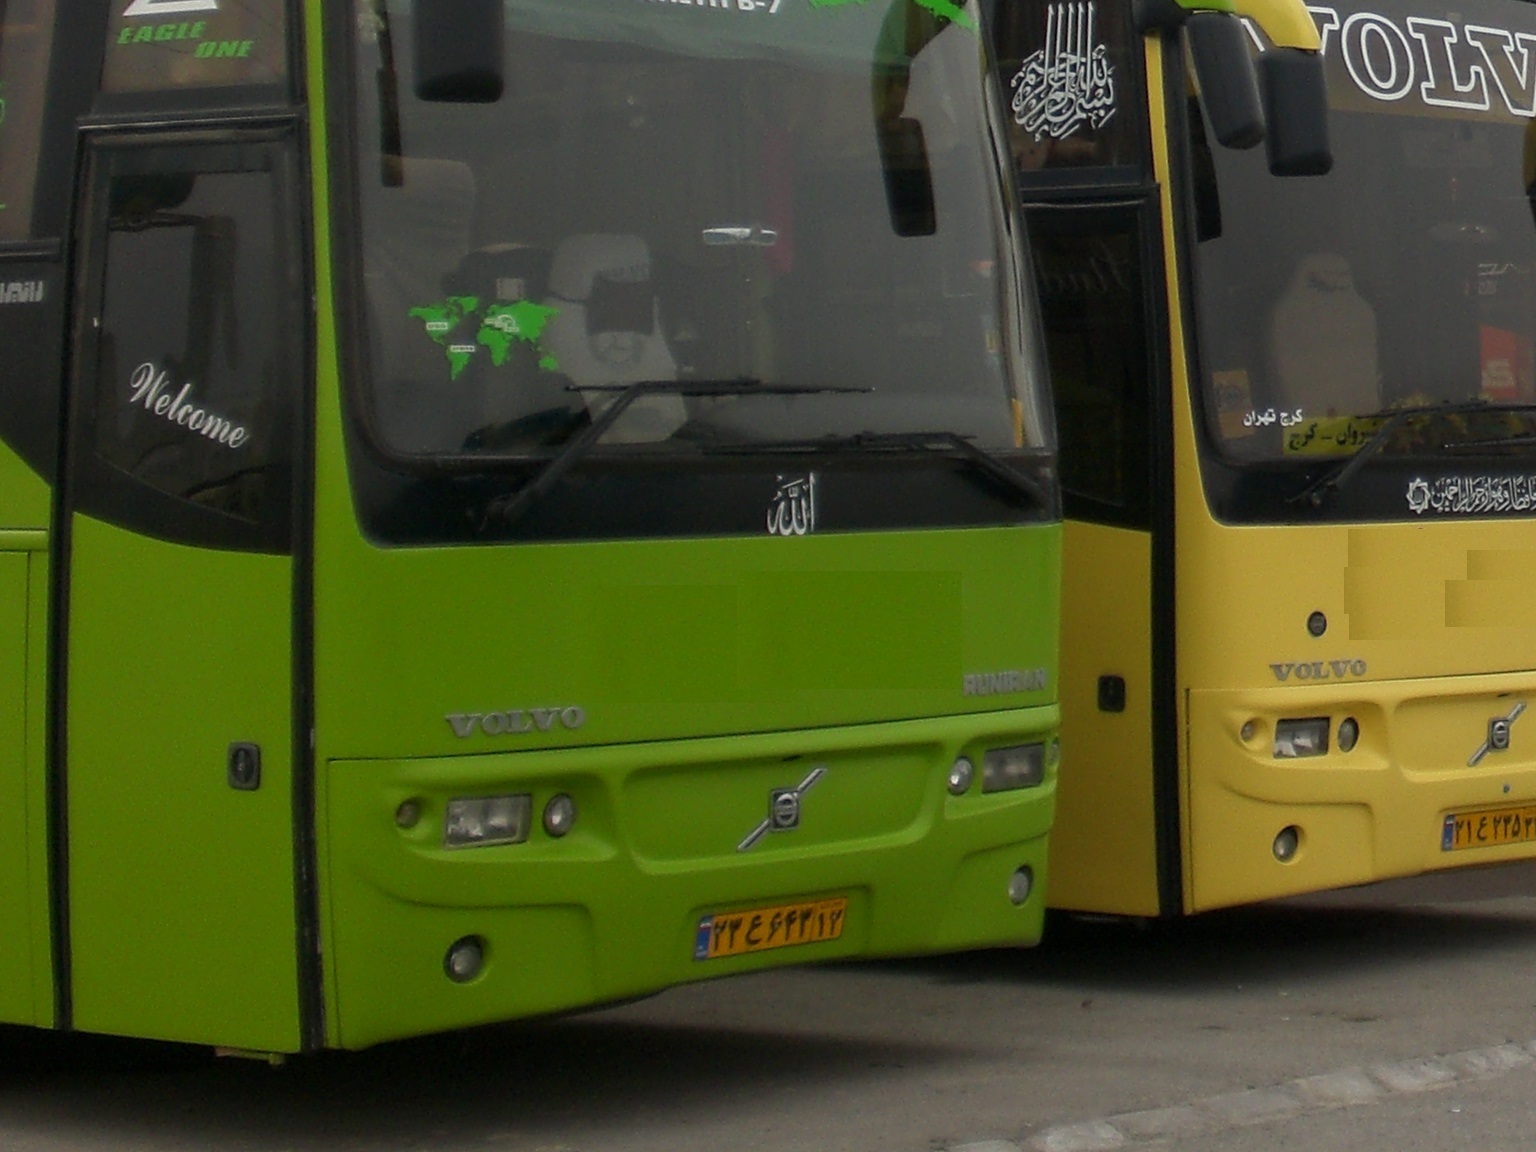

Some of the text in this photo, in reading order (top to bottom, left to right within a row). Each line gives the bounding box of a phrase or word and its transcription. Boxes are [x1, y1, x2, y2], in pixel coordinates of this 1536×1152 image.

[117, 22, 206, 45] EAGLE
[194, 40, 255, 59] ONE
[130, 362, 250, 448] Welcome
[1243, 408, 1276, 426] تهران
[1269, 659, 1367, 682] VOLVO
[445, 706, 586, 738] VOLVO
